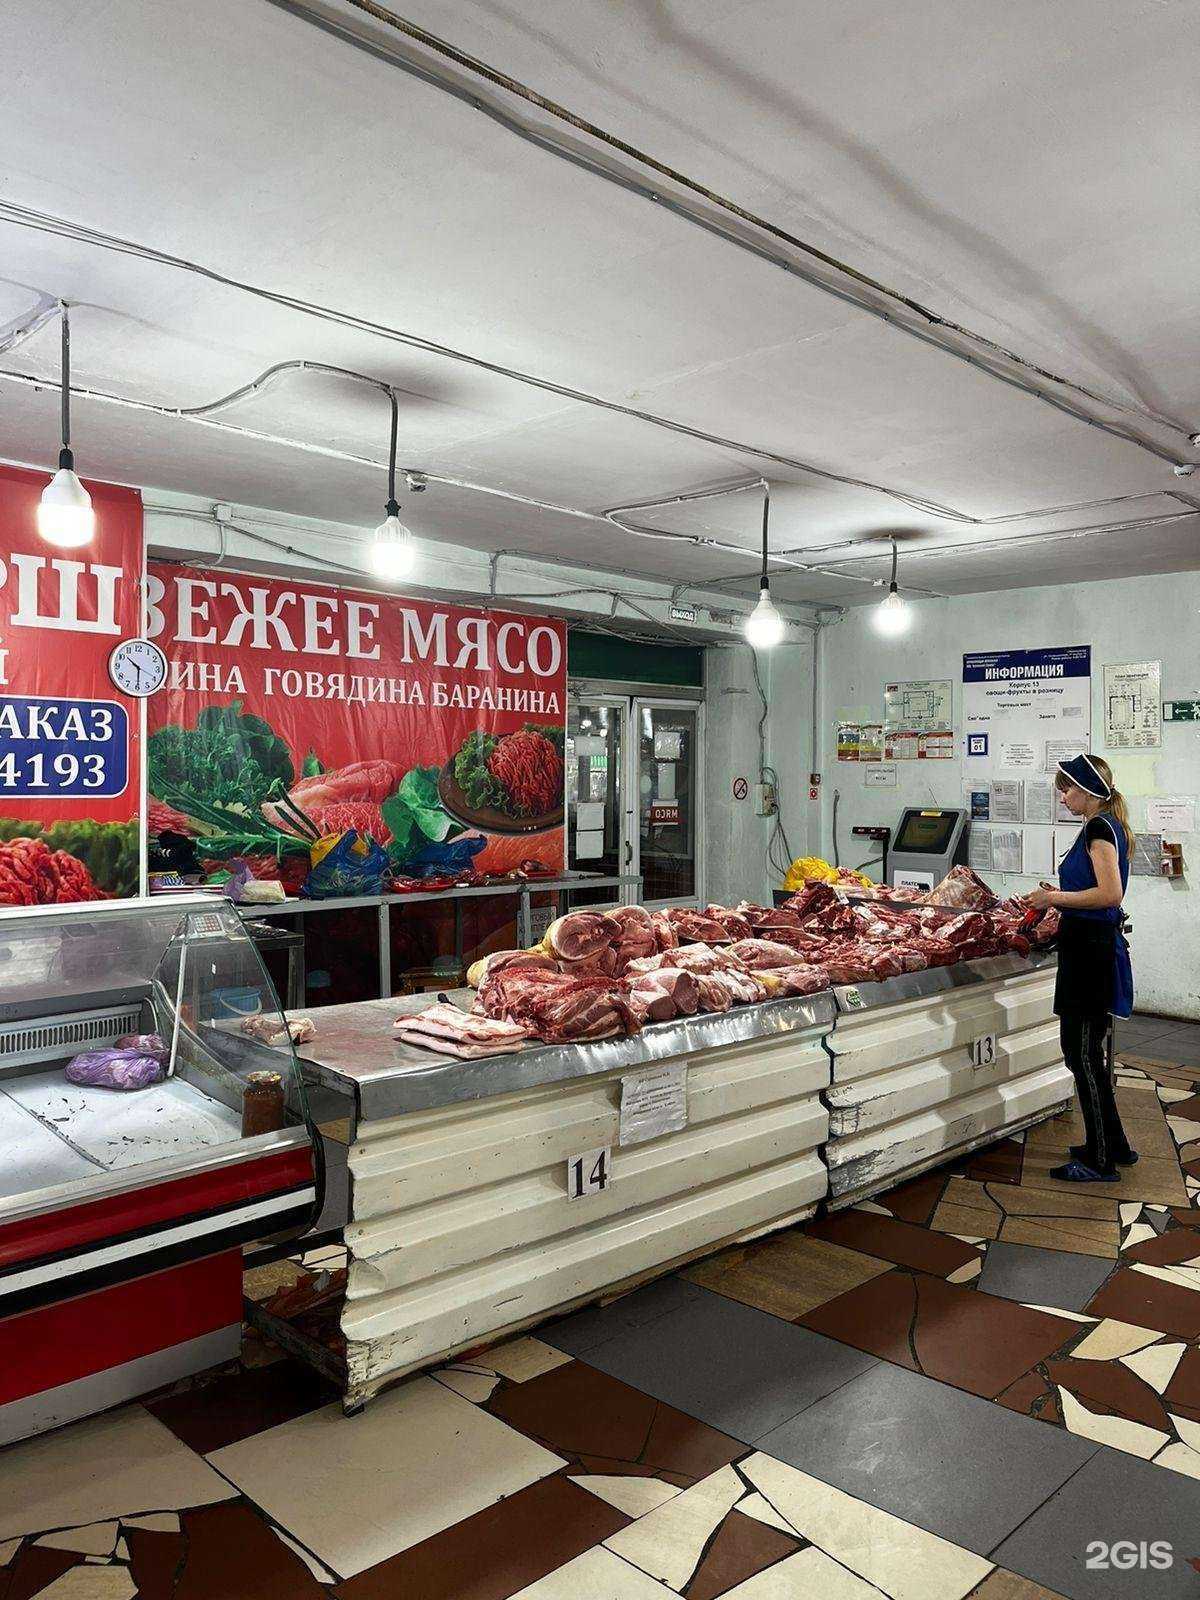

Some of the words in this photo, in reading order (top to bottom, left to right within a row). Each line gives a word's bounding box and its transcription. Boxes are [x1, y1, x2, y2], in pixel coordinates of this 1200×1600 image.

[0, 553, 124, 635] Ш
[400, 608, 561, 677] МЯСО
[160, 661, 247, 694] ИНА
[264, 668, 426, 708] ГОВЯДИНА
[432, 682, 560, 715] БАРАНИНА
[985, 664, 1064, 680] ИНФОРМАЦИЯ
[0, 752, 107, 788] 4193
[976, 1036, 994, 1066] 13
[571, 1150, 607, 1200] 14
